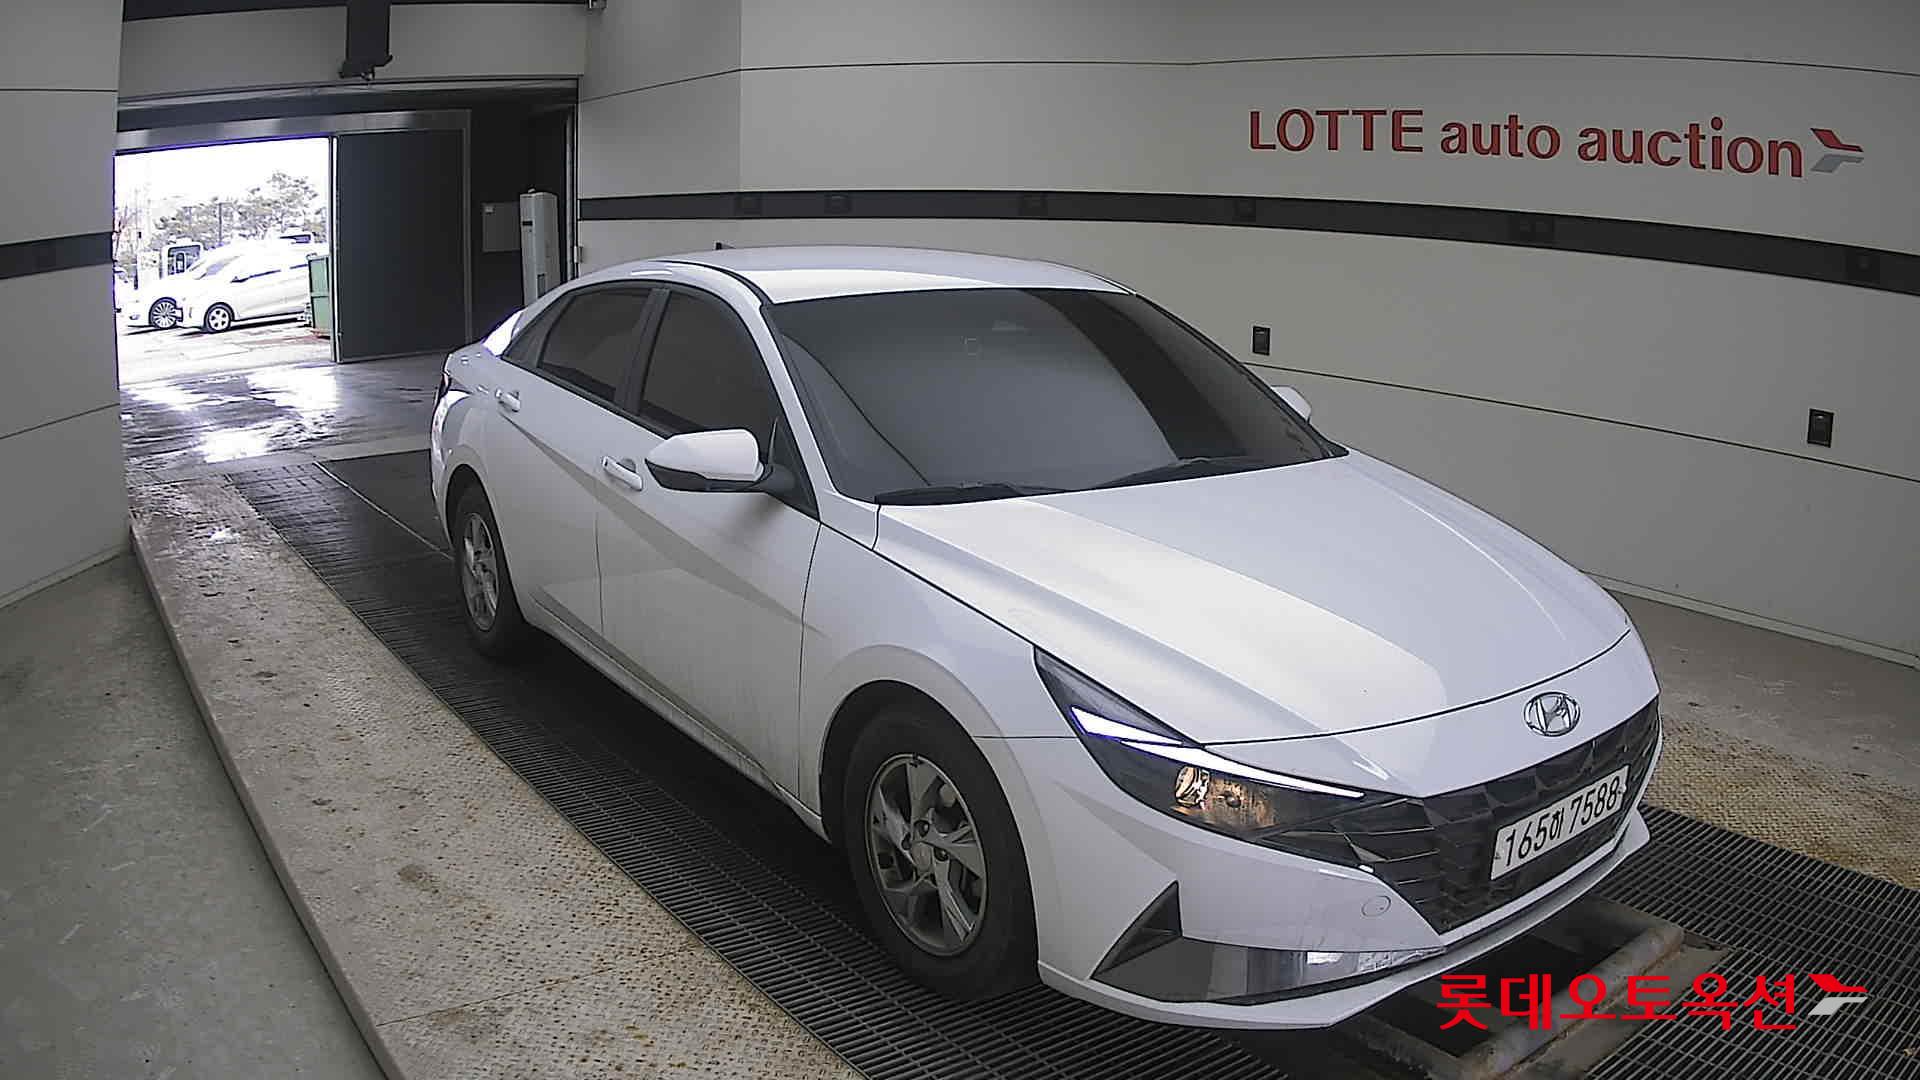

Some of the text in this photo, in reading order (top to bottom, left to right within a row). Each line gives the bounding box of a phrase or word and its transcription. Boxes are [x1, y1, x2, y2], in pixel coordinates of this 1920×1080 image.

[1249, 109, 1803, 178] LOTTE auto auction
[1569, 775, 1620, 834] 7588
